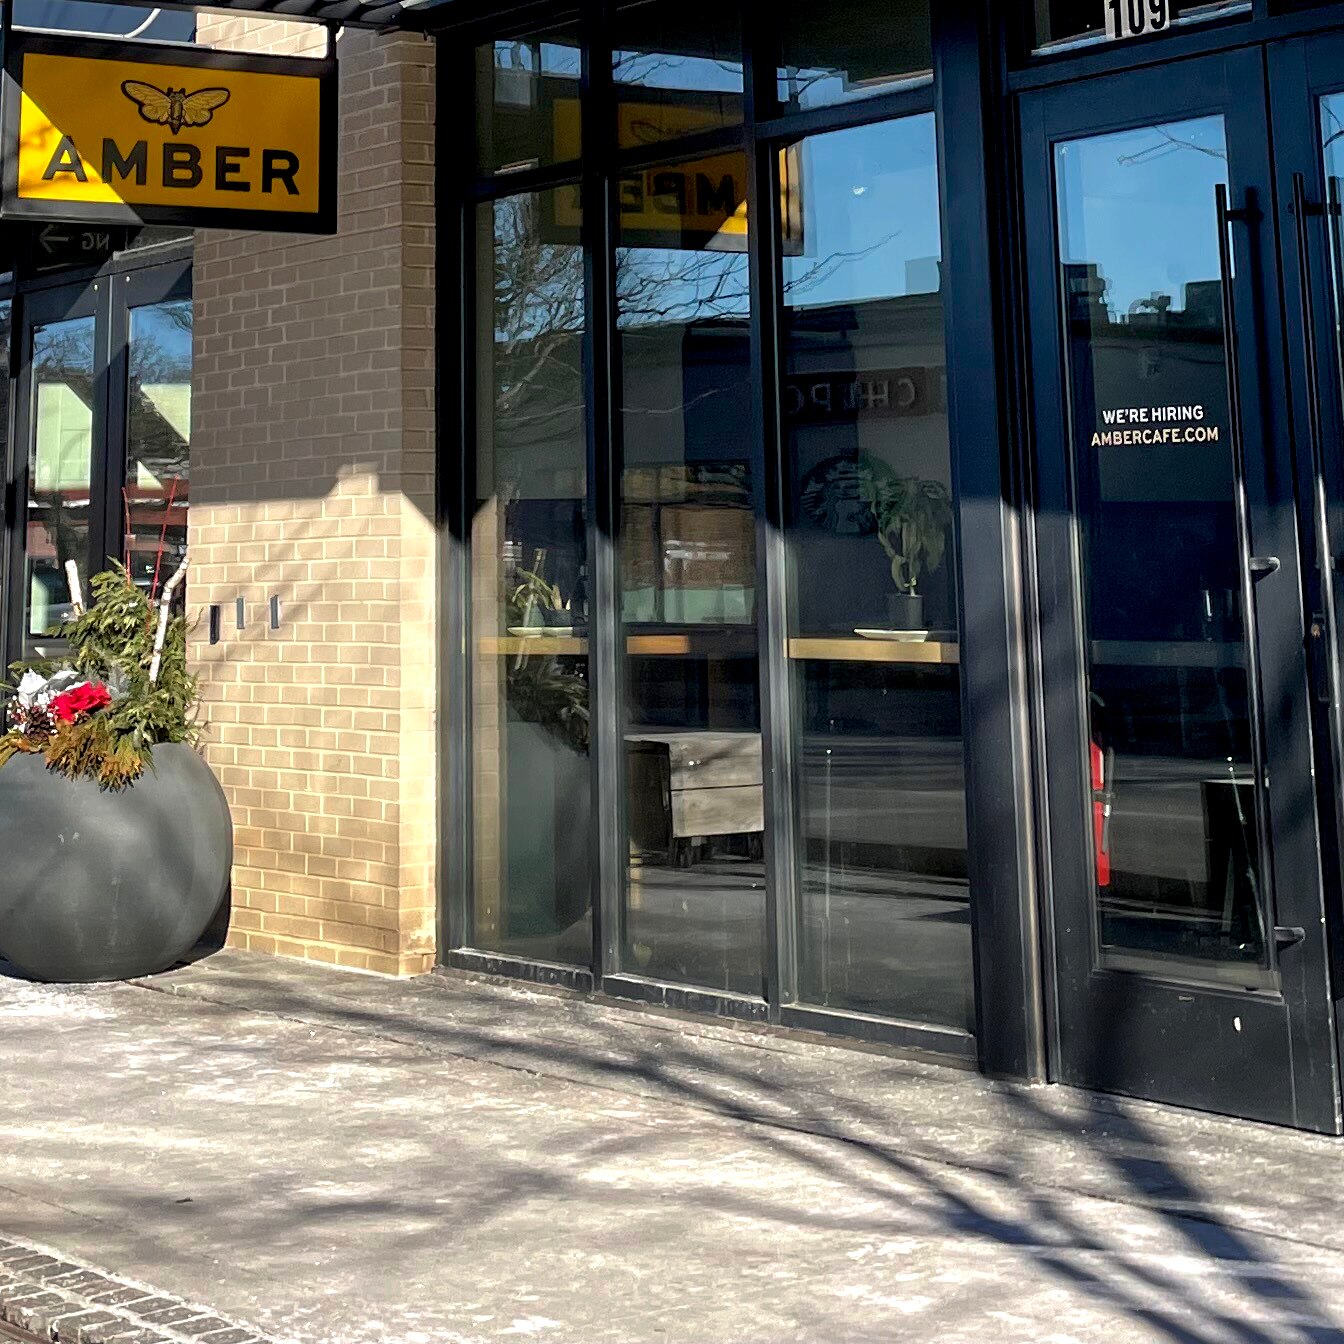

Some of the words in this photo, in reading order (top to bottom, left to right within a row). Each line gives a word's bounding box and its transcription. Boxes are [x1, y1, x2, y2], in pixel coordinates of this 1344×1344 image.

[42, 135, 300, 195] AMBER
[1102, 407, 1149, 424] WE'RE
[1151, 405, 1204, 422] HIRING
[1091, 426, 1219, 446] AMBERCAFE.COM
